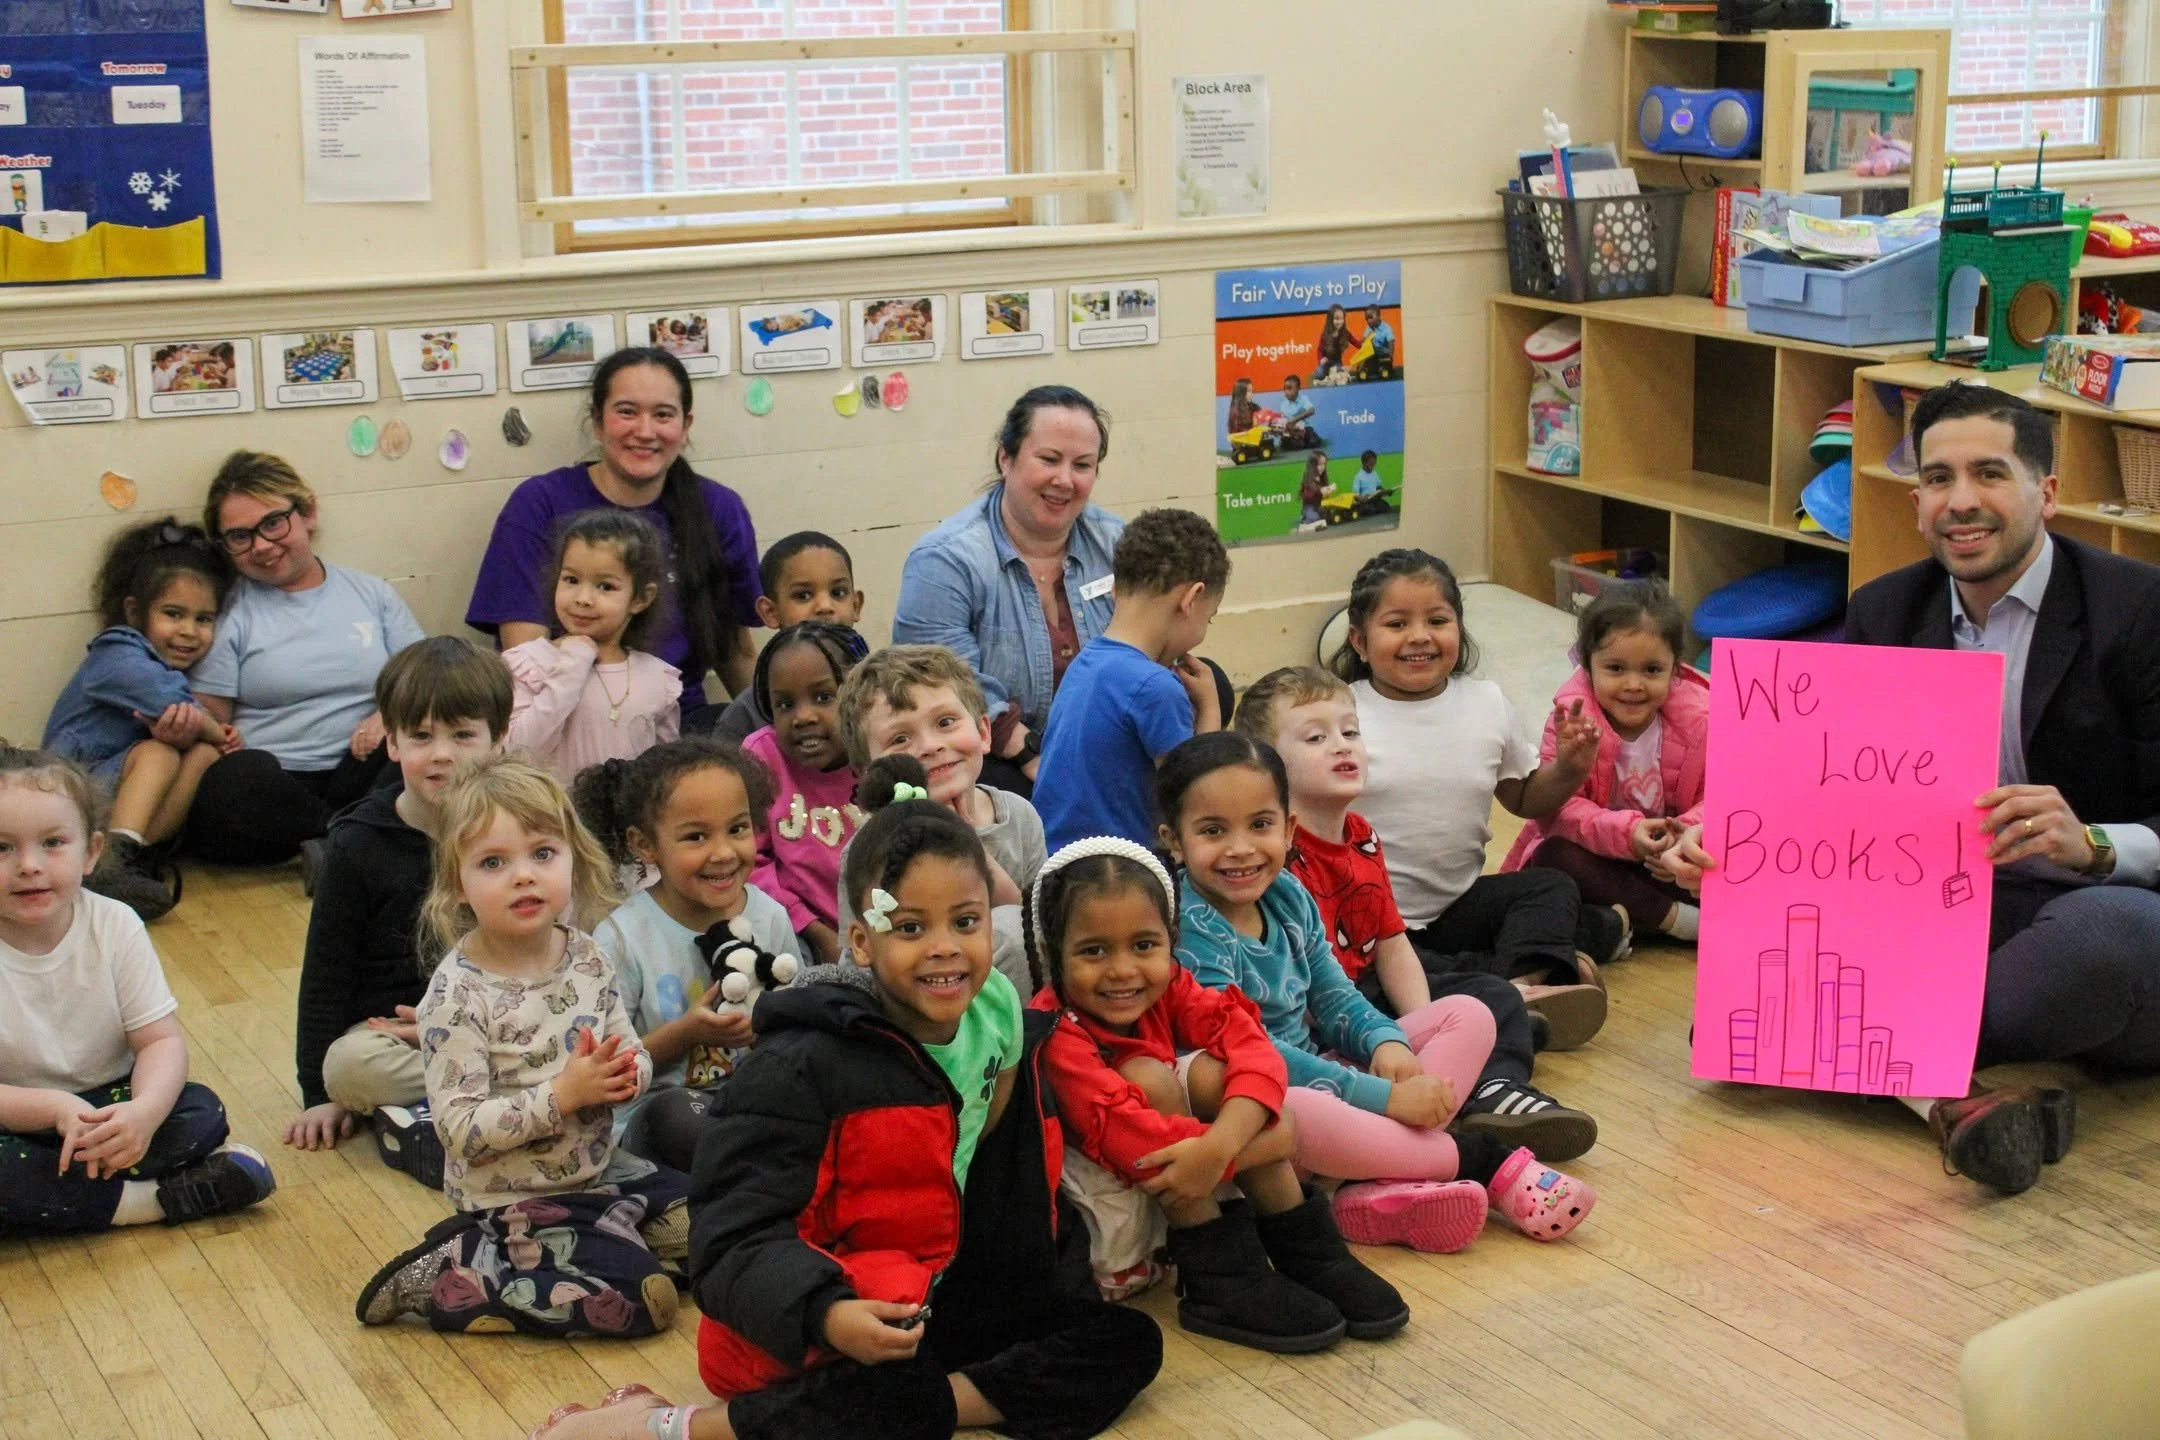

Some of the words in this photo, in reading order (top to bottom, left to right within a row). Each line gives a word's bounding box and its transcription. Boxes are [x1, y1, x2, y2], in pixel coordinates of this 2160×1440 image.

[102, 63, 165, 74] Tomorrow
[1186, 82, 1220, 95] Block
[1223, 82, 1252, 93] Area
[127, 100, 166, 111] Tuesday
[1232, 283, 1267, 303] Fair
[1271, 279, 1323, 306] Ways
[1326, 280, 1344, 296] to
[1348, 273, 1386, 299] Play
[1222, 344, 1253, 364] Play
[1255, 340, 1313, 361] together
[1338, 408, 1376, 424] Trade
[1223, 493, 1253, 508] Take
[1256, 491, 1292, 505] turns
[1730, 648, 1819, 723] We
[1820, 731, 1938, 786] Love
